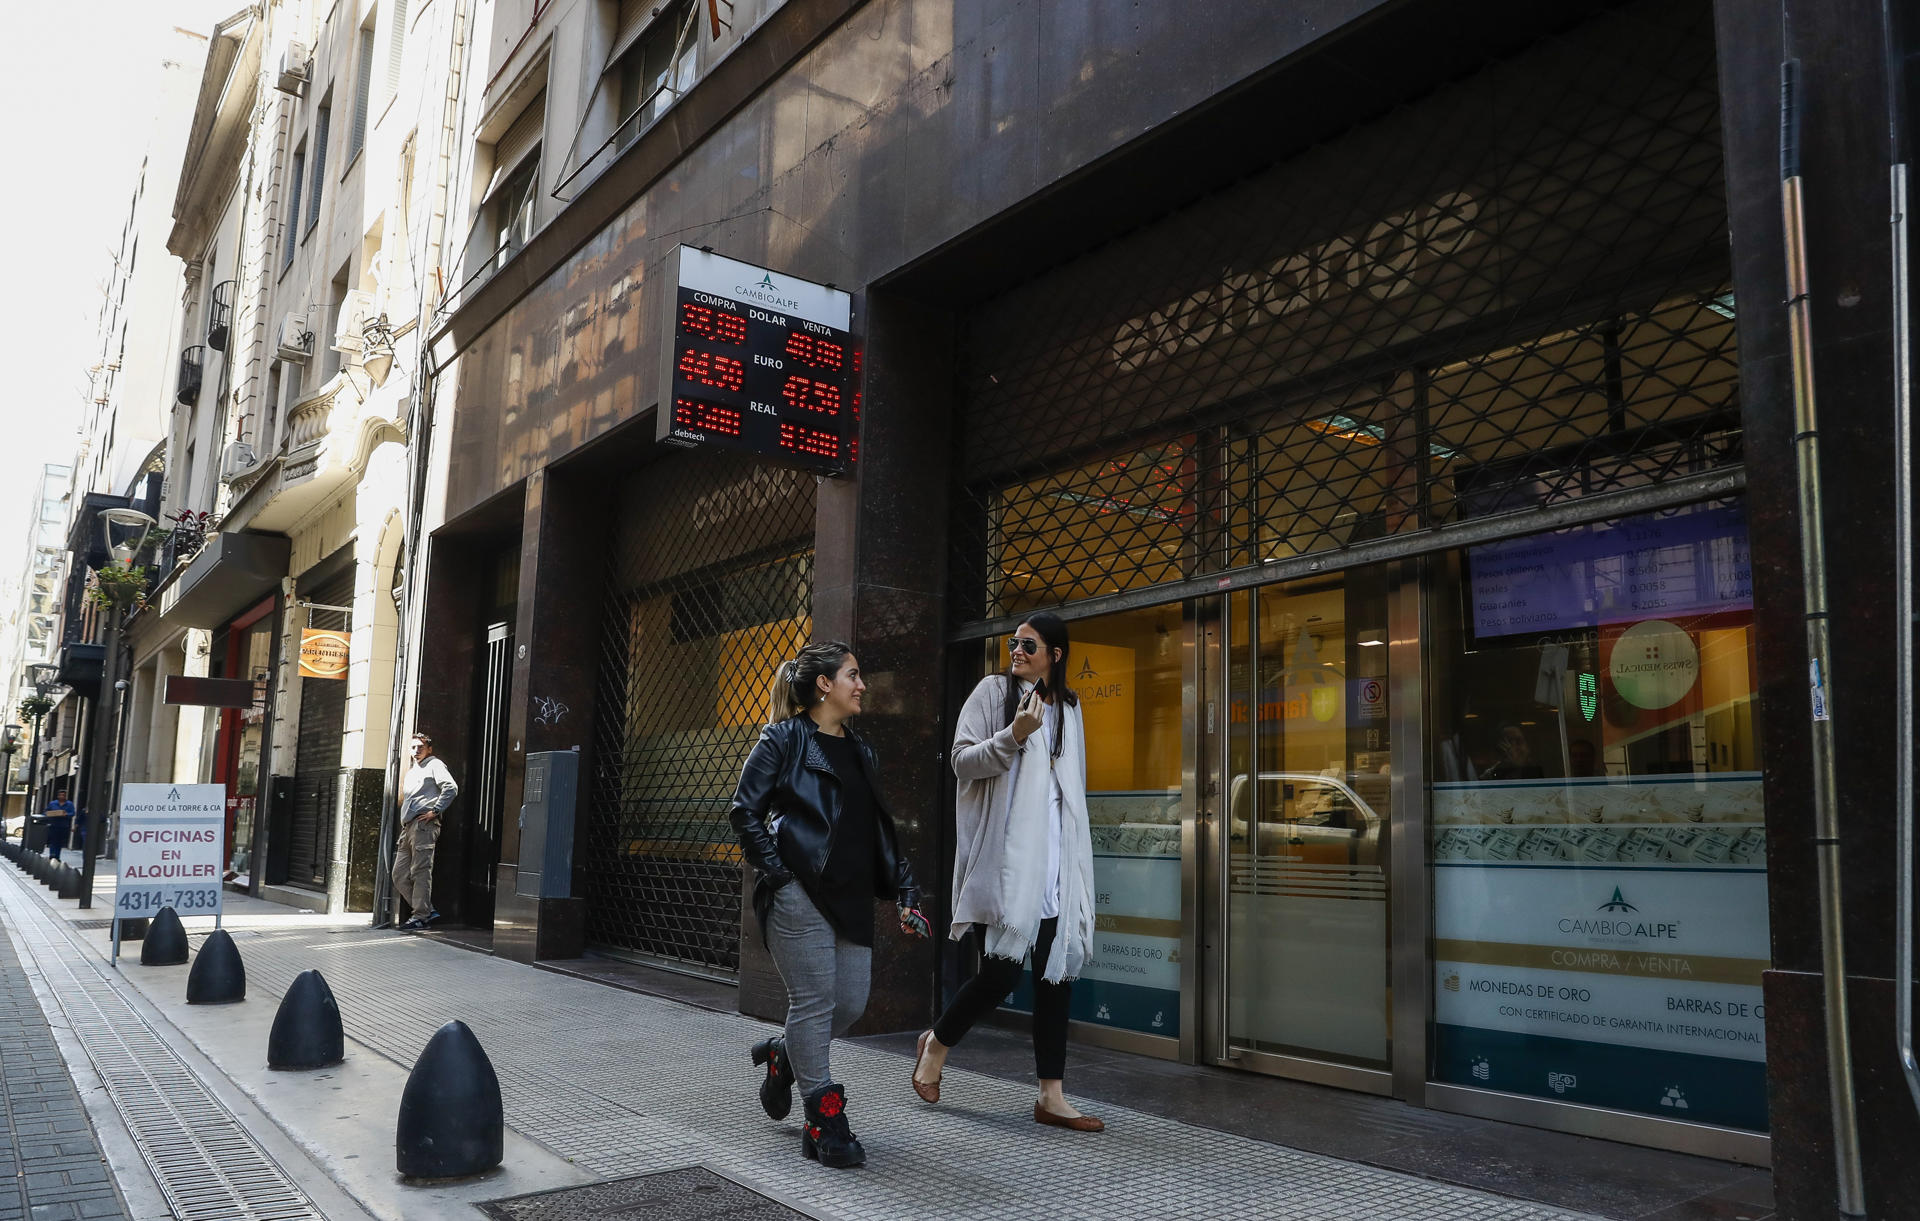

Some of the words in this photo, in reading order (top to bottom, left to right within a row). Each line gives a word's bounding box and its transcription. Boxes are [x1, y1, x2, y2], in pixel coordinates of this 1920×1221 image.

[1112, 191, 1478, 371] exchange
[694, 292, 737, 312] COMPRA
[749, 309, 787, 327] DOLAR
[802, 321, 832, 337] VENTA
[754, 354, 783, 370] EURO
[750, 401, 777, 416] REAL
[674, 428, 705, 442] debtech
[128, 830, 215, 843] OFICINAS
[161, 850, 181, 860] EN
[125, 864, 215, 878] ALQUILER
[119, 889, 217, 911] 4314-7333
[1102, 943, 1130, 956] BARRAS
[1132, 946, 1142, 958] DE
[1143, 948, 1162, 960] ORO
[1102, 962, 1149, 975] INTERNACIONAL
[1551, 950, 1621, 970] COMPRA
[1639, 956, 1692, 975] VENTA
[1469, 979, 1534, 998] MONEDAS
[1537, 985, 1555, 999] DE
[1559, 987, 1591, 1002] ORO
[1667, 996, 1723, 1016] BARRAS
[1728, 1002, 1748, 1018] DE
[1499, 1005, 1522, 1017] CON
[1525, 1007, 1590, 1026] CERTIFICADO
[1593, 1014, 1606, 1027] DE
[1610, 1016, 1664, 1034] GARANTIA
[1666, 1023, 1762, 1044] INTERNACIONAL
